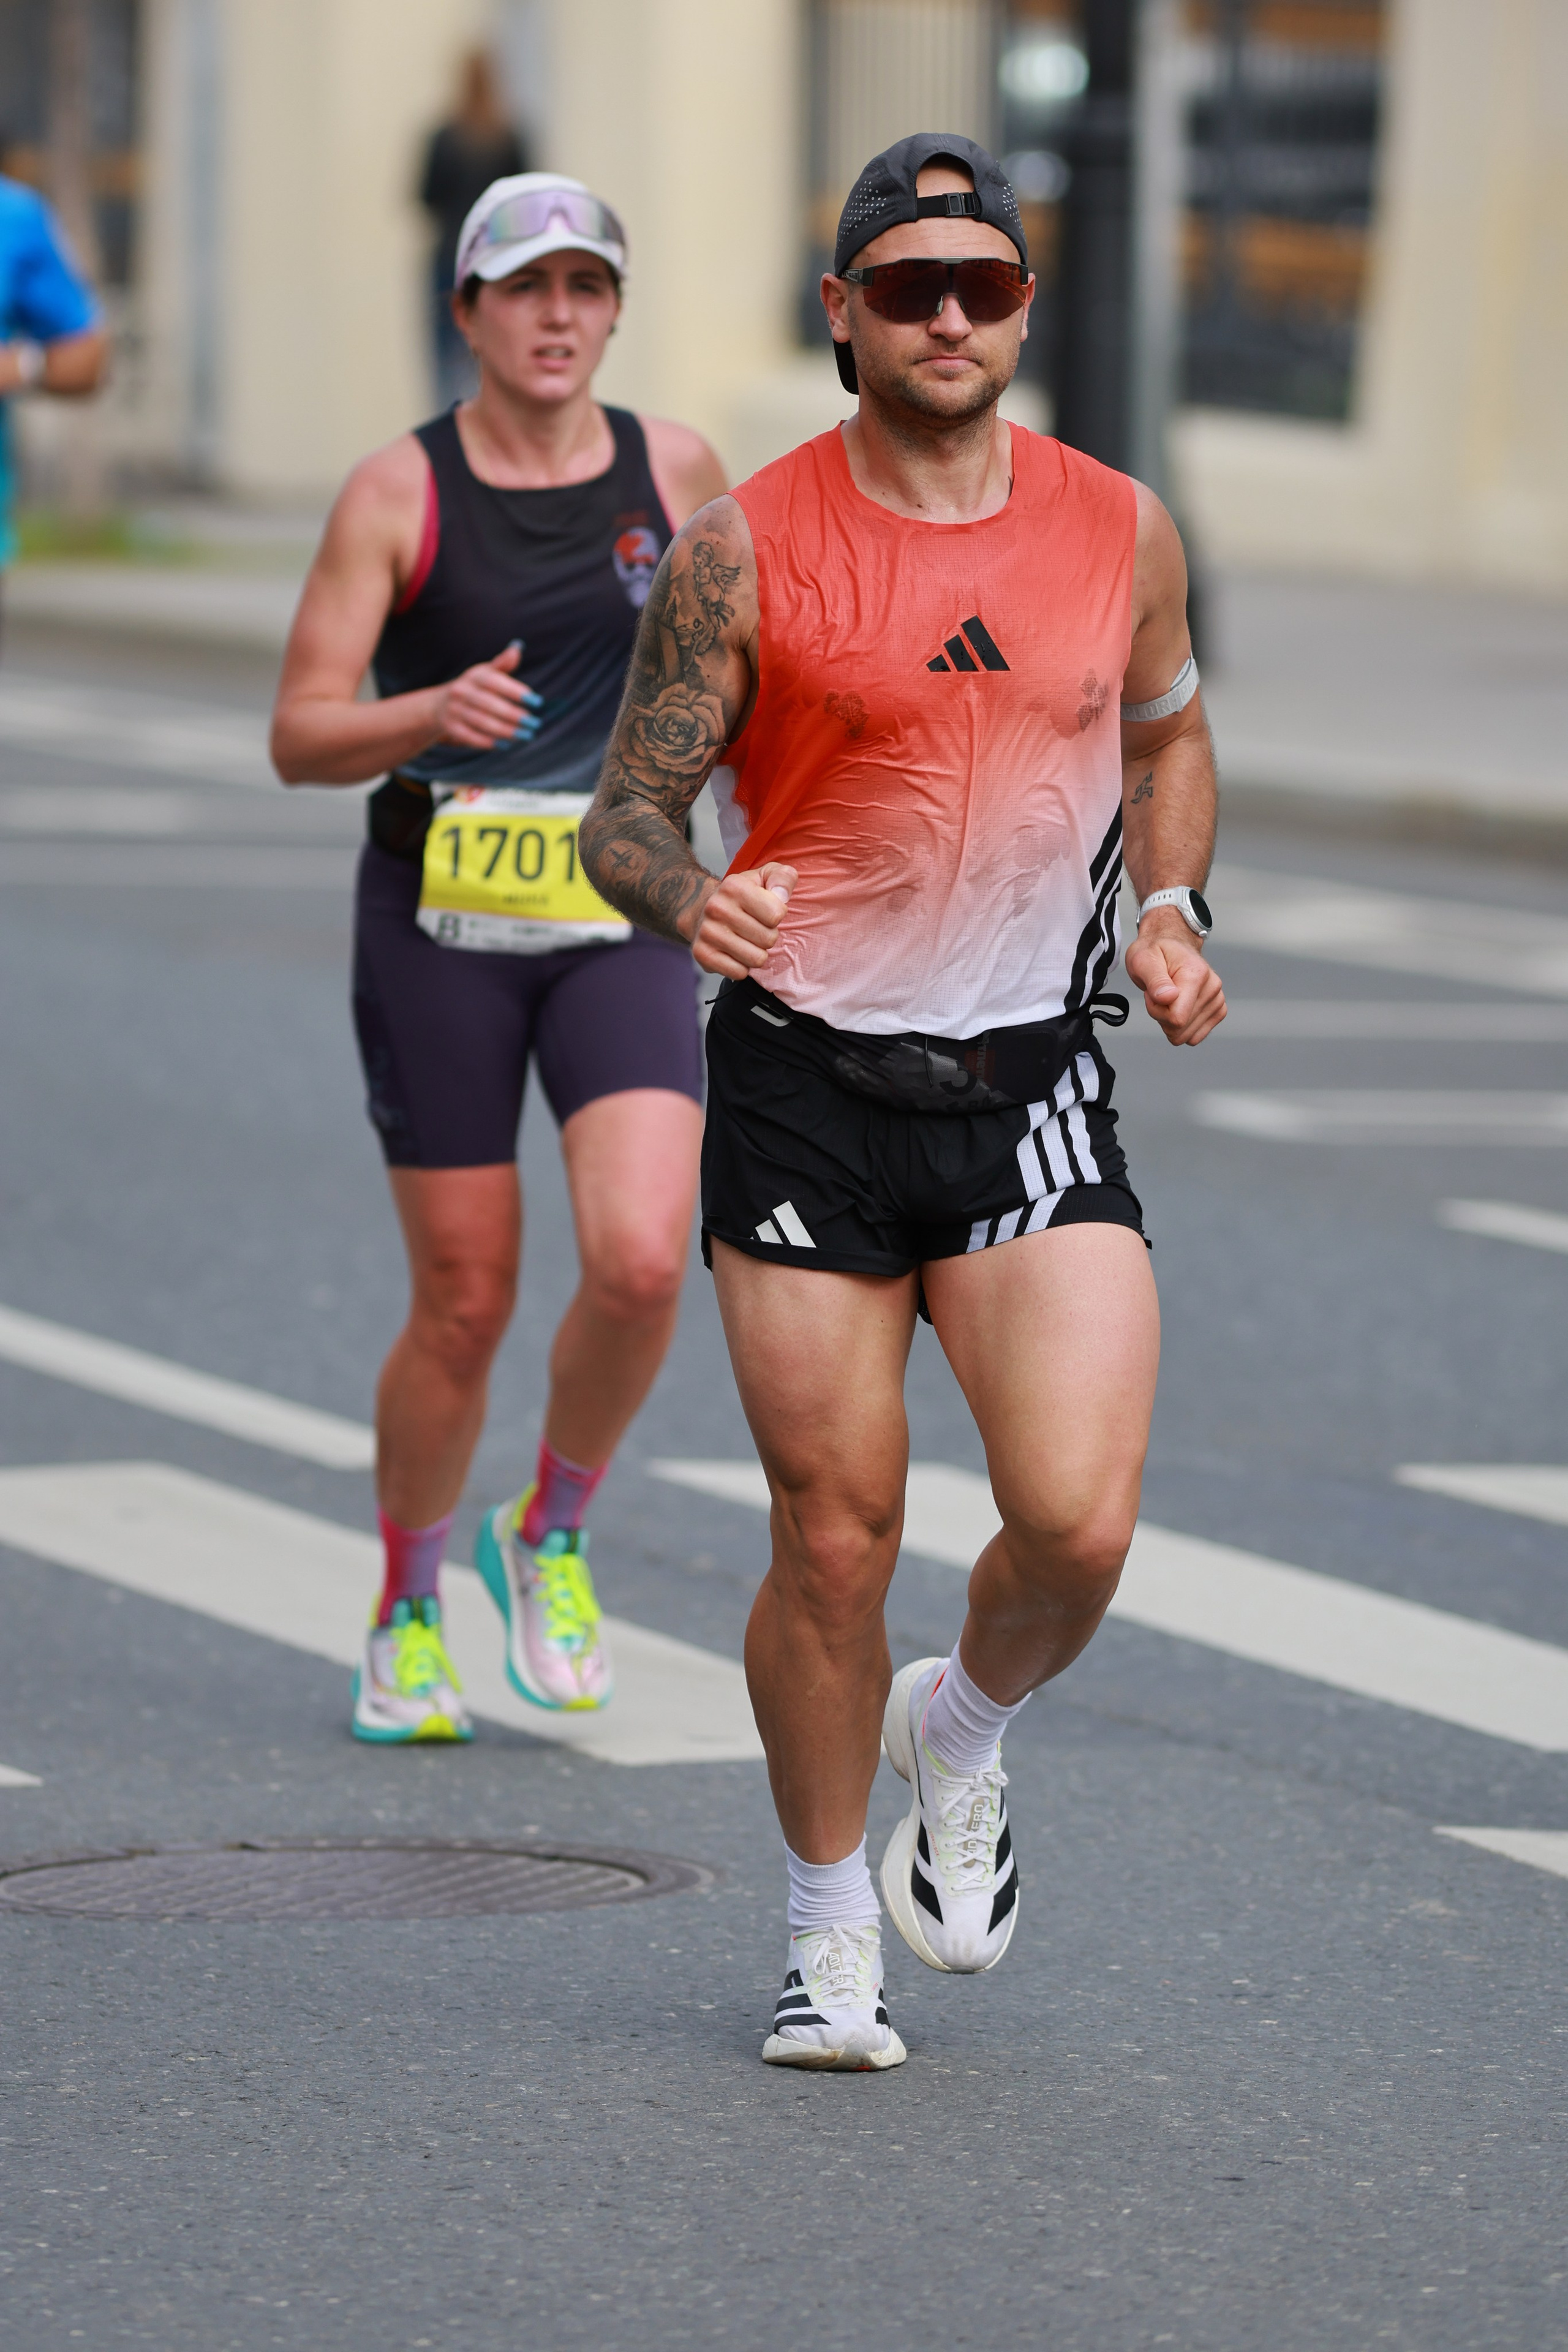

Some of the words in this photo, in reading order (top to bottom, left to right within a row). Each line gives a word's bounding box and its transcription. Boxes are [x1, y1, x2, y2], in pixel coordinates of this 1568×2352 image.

[1121, 693, 1177, 718] PLORE
[441, 825, 575, 881] 1701
[828, 1952, 843, 1986] ADIZR
